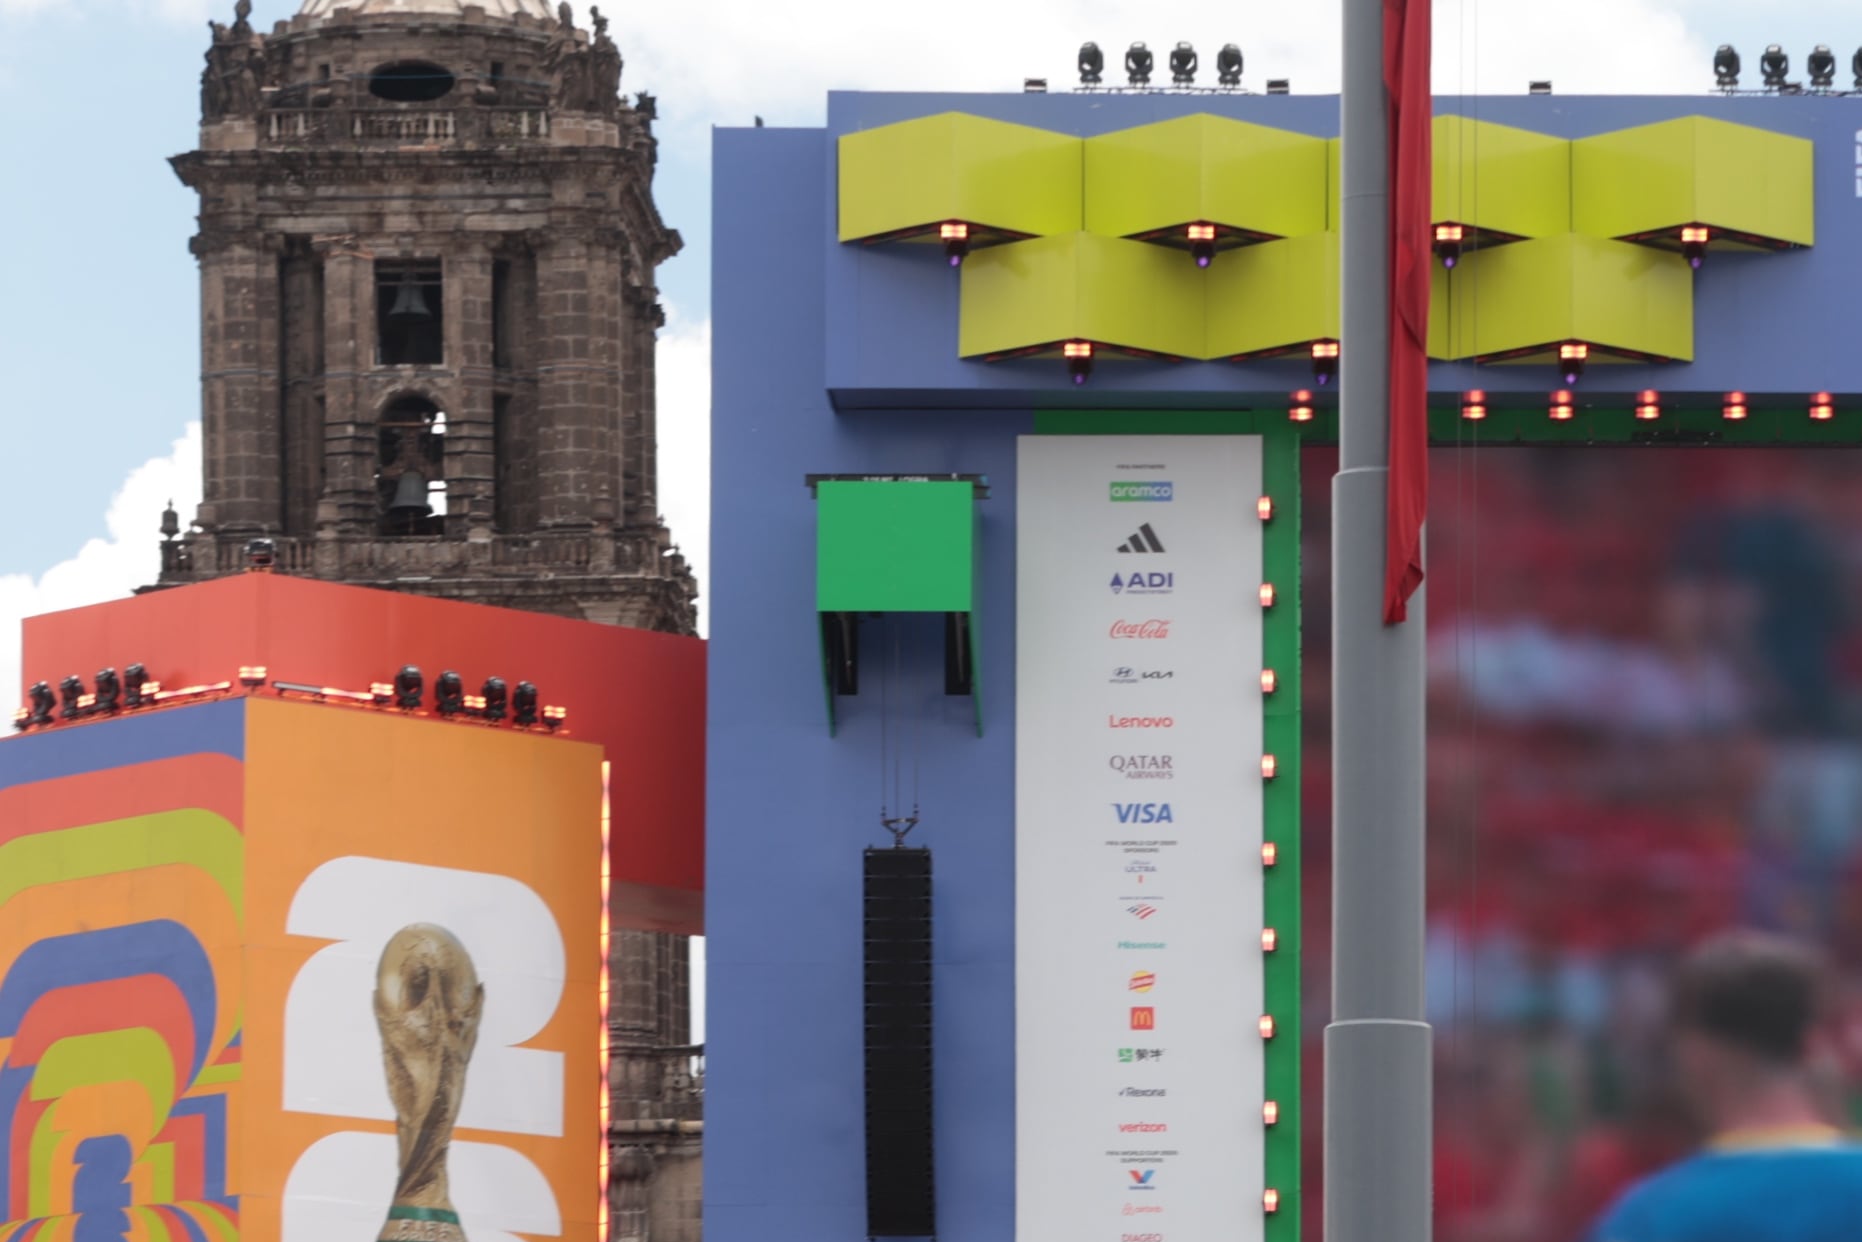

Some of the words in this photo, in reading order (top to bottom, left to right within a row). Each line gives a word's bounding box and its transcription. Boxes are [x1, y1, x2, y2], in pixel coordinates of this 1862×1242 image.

[1110, 486, 1172, 497] aramco
[1127, 572, 1174, 588] ADI
[1109, 715, 1173, 728] Lenovo
[1109, 755, 1173, 773] QATAR
[1112, 803, 1173, 823] VISA
[1119, 1122, 1168, 1133] verizon
[1121, 1233, 1163, 1242] DIAGEO
